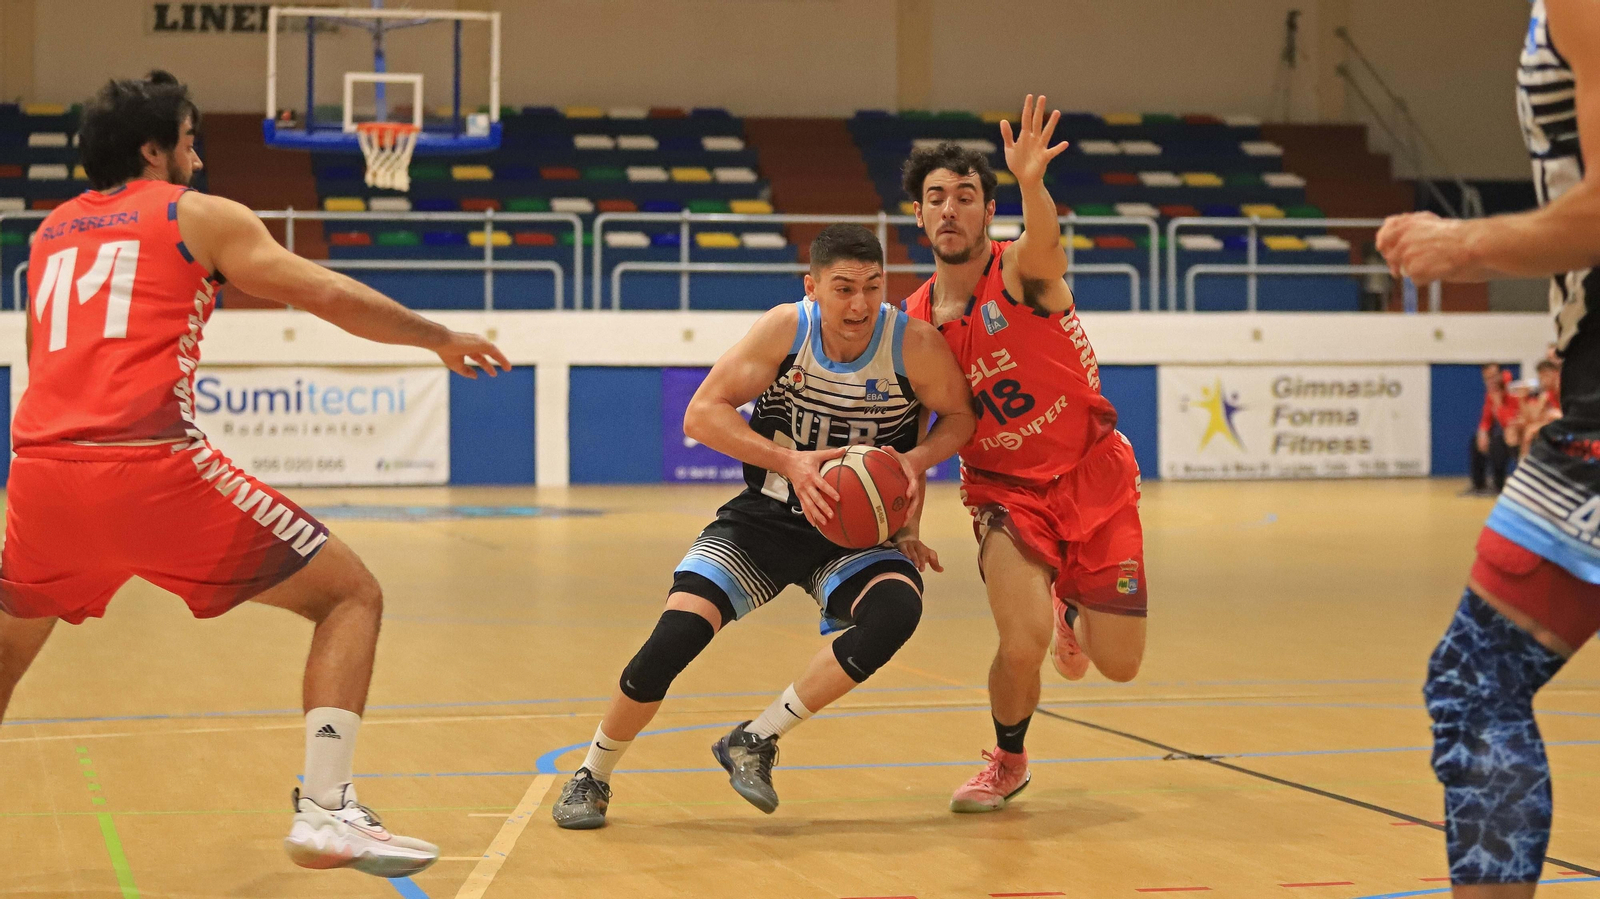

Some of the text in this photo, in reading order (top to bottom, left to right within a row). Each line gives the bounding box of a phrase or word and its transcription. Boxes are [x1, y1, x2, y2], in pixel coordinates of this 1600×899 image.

[41, 210, 139, 242] RUI PEREIRA
[35, 239, 141, 353] 11
[195, 376, 406, 416] Sumitecni
[866, 393, 884, 401] EBA
[1270, 375, 1403, 399] Gimnasio
[1270, 404, 1359, 426] Forma
[1270, 433, 1372, 455] Fitness
